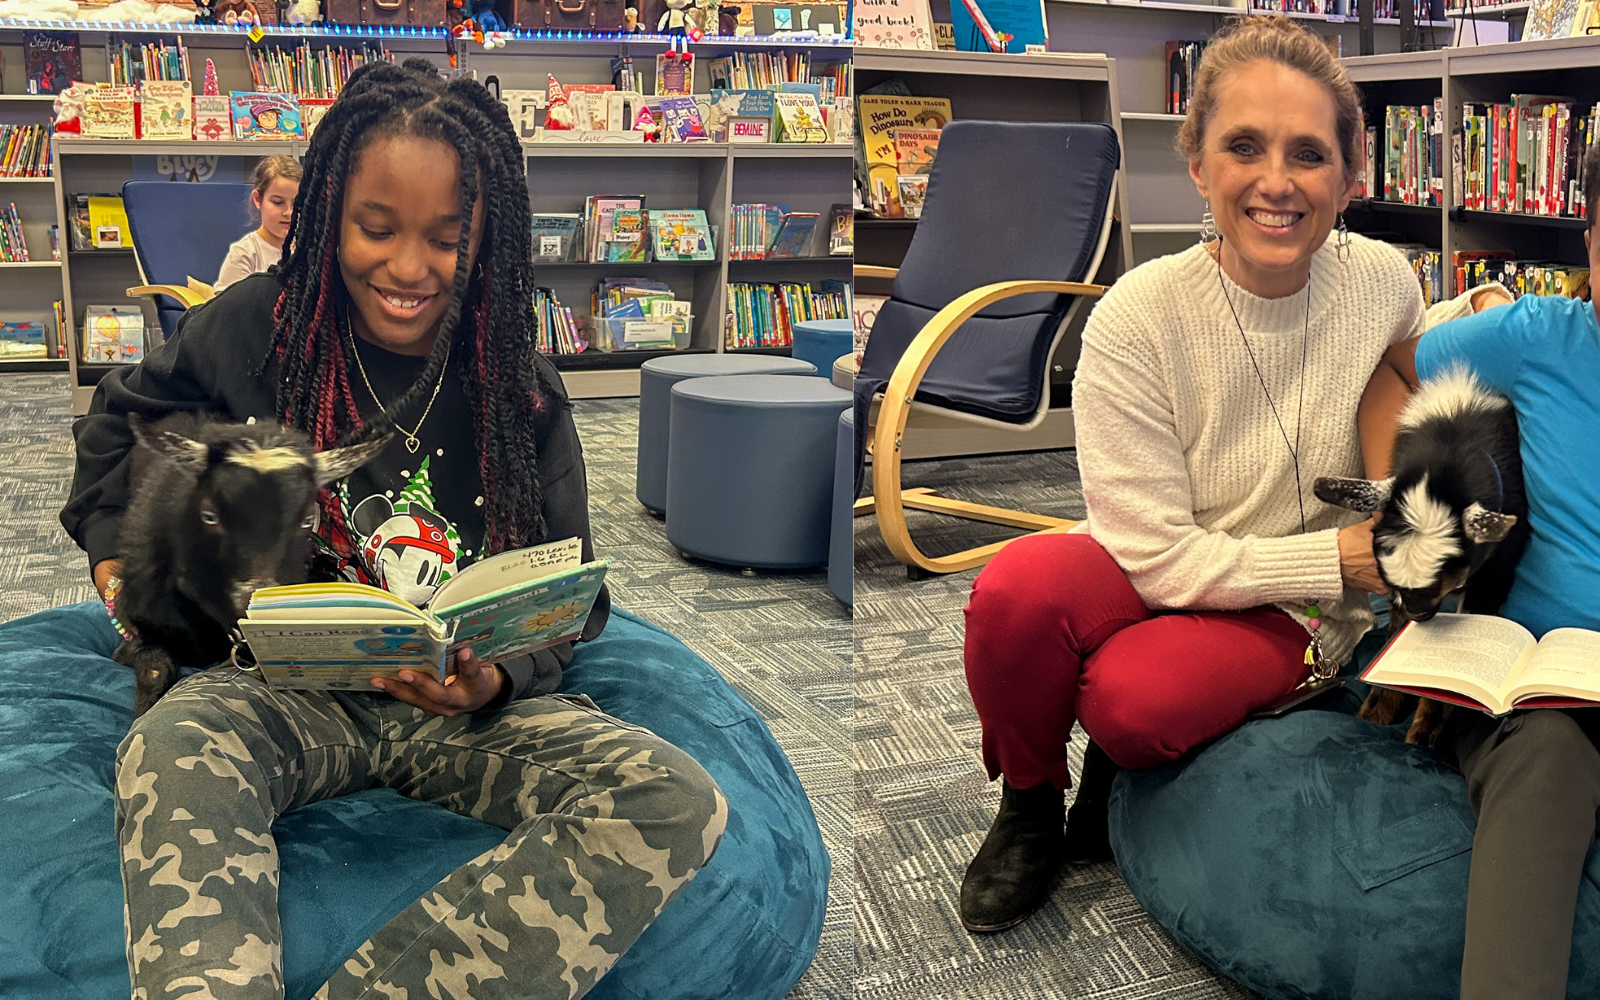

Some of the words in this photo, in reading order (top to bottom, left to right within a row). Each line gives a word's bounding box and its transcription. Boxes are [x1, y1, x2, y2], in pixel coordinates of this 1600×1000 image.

[858, 14, 883, 27] good
[887, 15, 914, 28] book!
[30, 34, 52, 50] Stuff
[870, 111, 891, 123] How
[893, 108, 906, 117] Do
[870, 119, 914, 135] Dinosaurs
[579, 131, 601, 142] love
[1454, 144, 1460, 163] S
